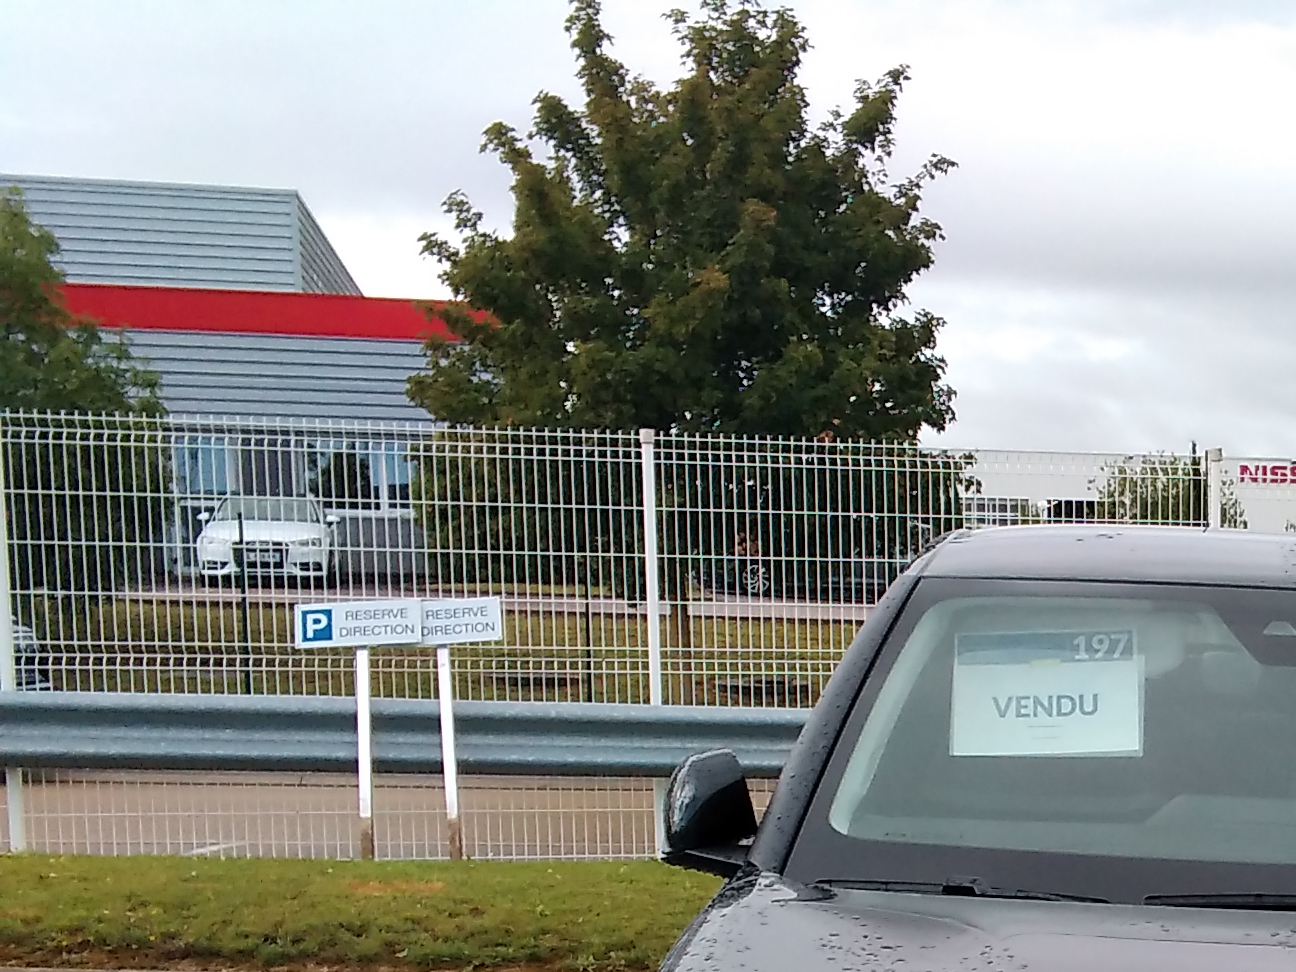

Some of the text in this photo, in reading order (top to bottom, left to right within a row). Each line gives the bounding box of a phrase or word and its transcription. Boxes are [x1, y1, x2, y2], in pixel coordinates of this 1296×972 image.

[344, 607, 409, 622] RESERVE
[425, 606, 489, 621] RESERVE
[306, 612, 328, 639] P
[338, 623, 416, 638] DIRECTION
[421, 621, 496, 638] DIRECTION
[1072, 633, 1129, 661] 197
[992, 693, 1099, 719] VENDU
